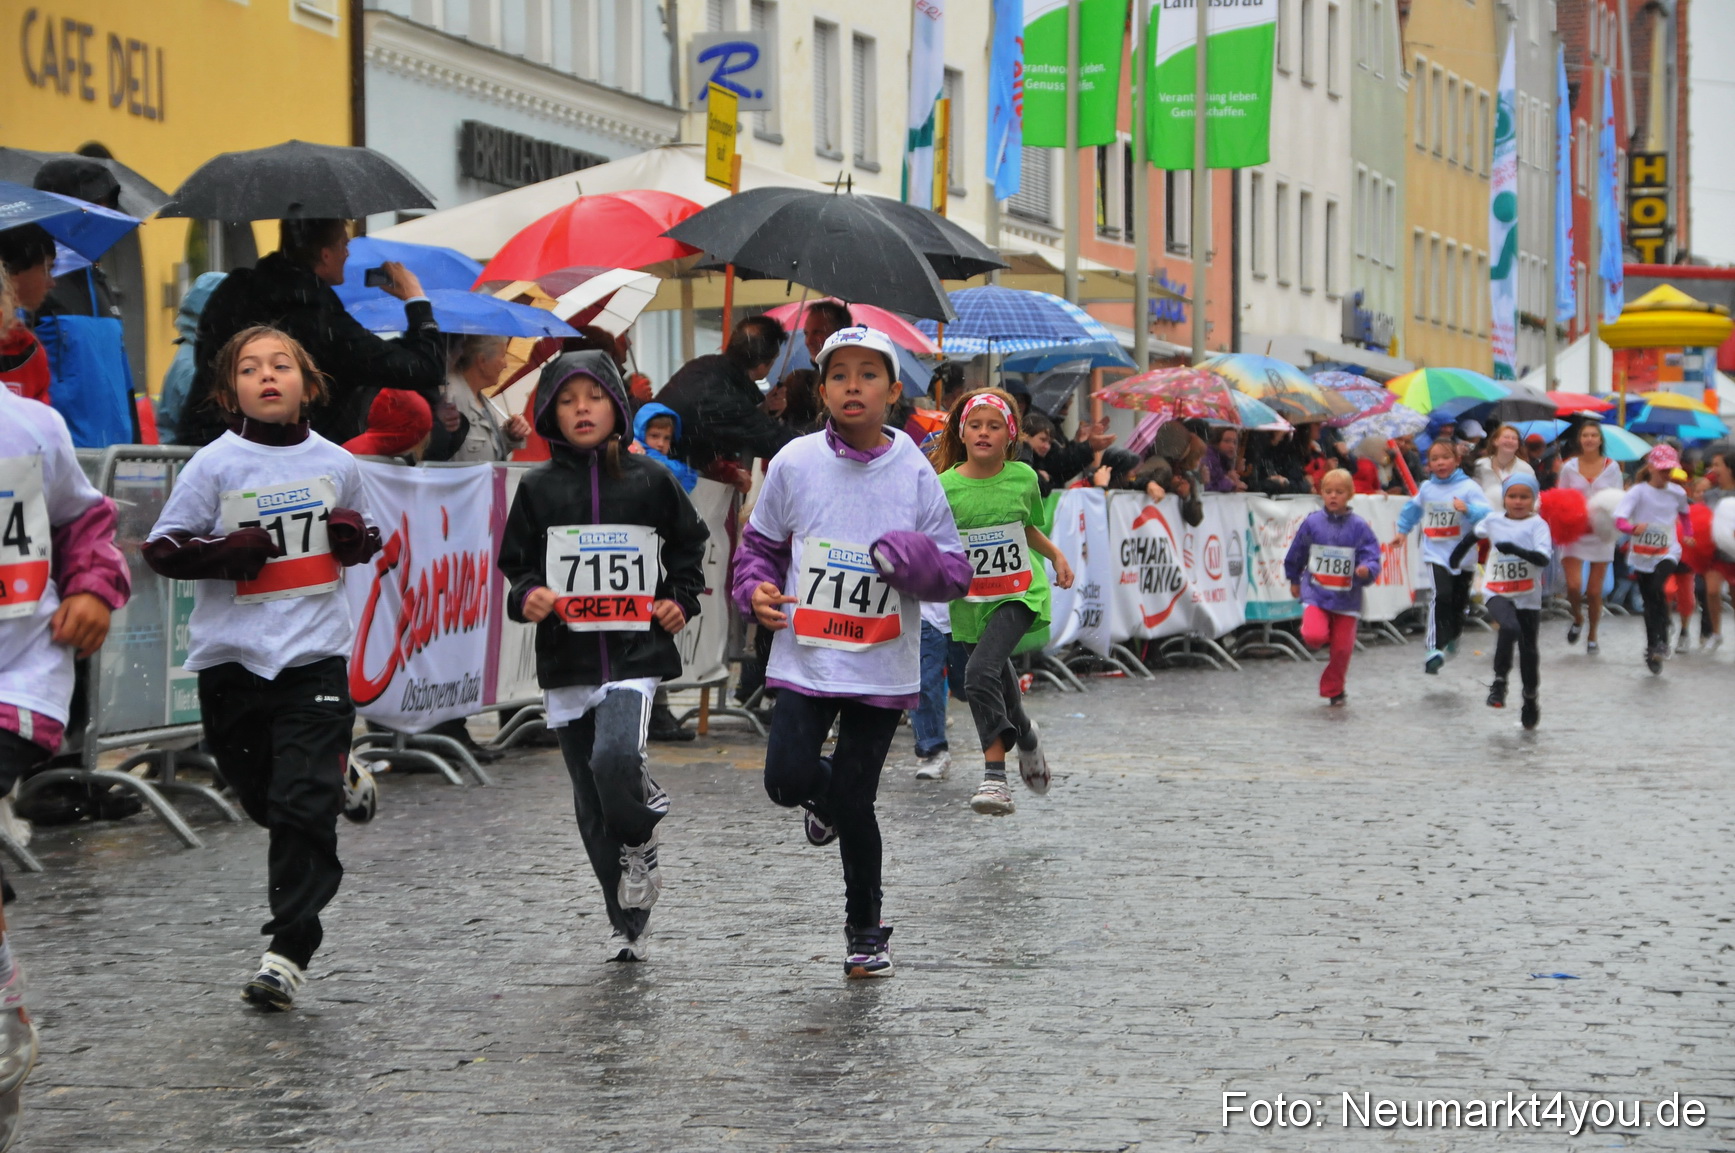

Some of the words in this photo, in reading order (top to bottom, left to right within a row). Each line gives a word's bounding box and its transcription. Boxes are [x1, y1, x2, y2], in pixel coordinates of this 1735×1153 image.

[20, 8, 95, 102] CAFE
[106, 31, 165, 122] DELI
[1025, 78, 1065, 91] Genuss
[1229, 91, 1259, 102] leben.
[257, 488, 311, 509] BOCK
[1428, 511, 1457, 527] 7137
[579, 532, 628, 545] BOCK
[968, 530, 1005, 543] BOCK
[560, 554, 645, 593] 7151
[1315, 556, 1352, 575] 7188
[1493, 562, 1529, 580] 7185
[806, 567, 891, 614] 7147
[565, 597, 638, 619] GRETA
[823, 618, 864, 639] Julia
